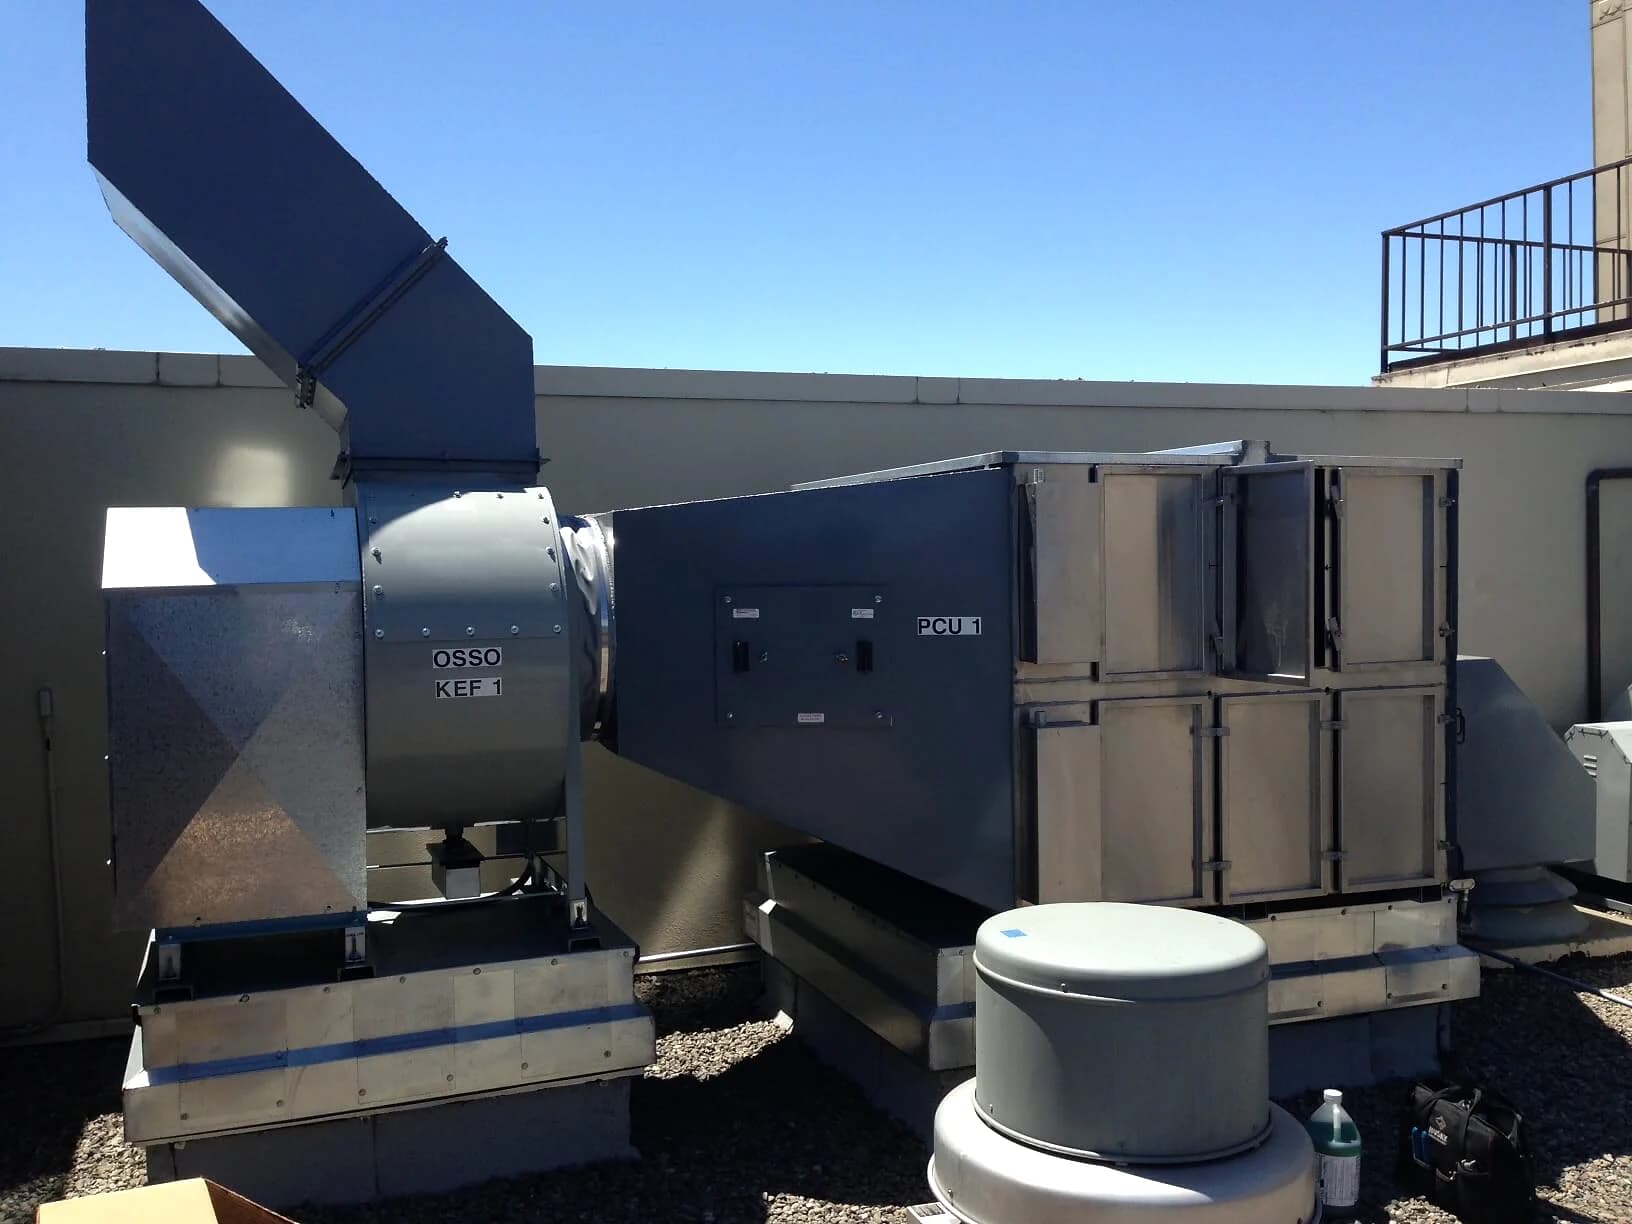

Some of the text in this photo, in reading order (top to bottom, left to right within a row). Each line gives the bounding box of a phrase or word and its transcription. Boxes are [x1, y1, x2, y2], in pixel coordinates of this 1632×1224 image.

[918, 618, 980, 635] PCU 1
[433, 648, 501, 668] OSSO
[436, 679, 501, 698] KEF 1
